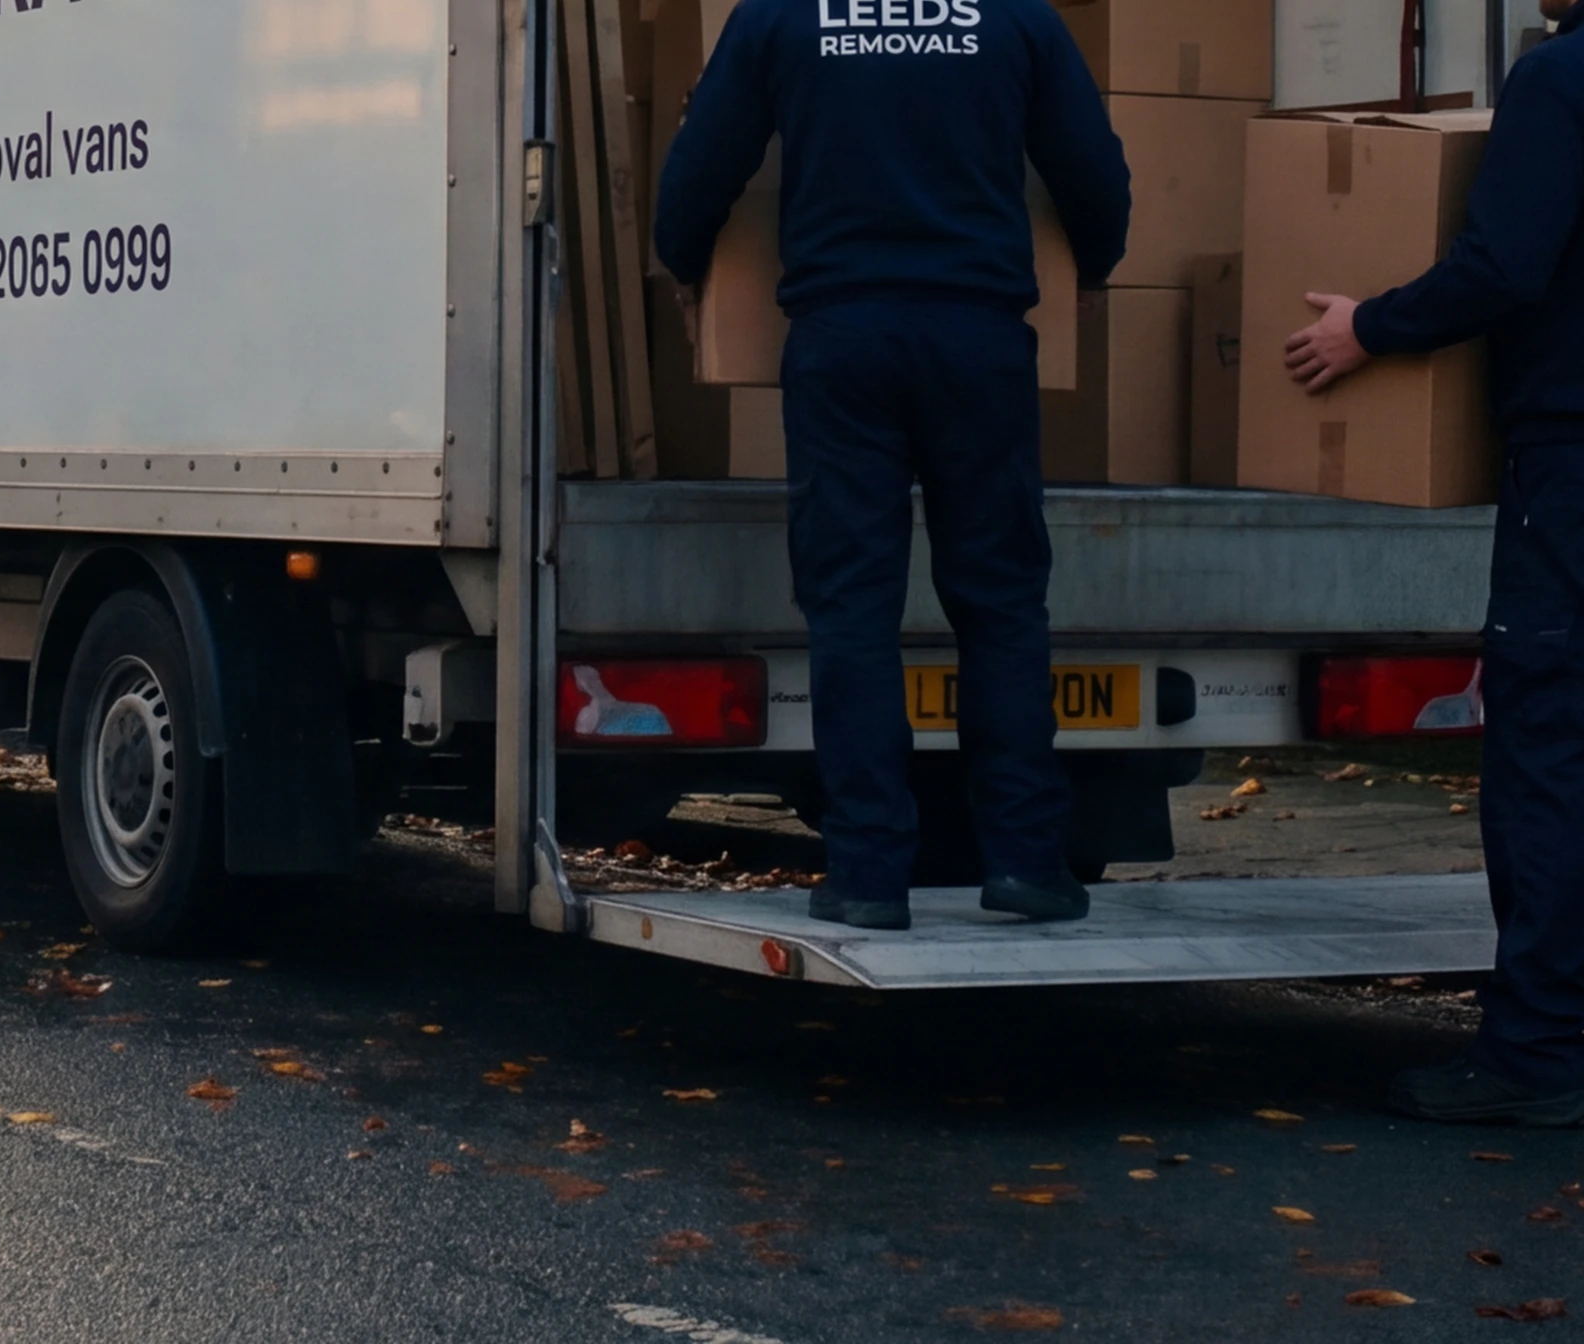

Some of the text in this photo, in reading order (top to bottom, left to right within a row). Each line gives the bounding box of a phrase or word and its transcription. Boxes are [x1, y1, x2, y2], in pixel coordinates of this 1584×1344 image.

[820, 33, 979, 57] REMOVALS
[62, 118, 150, 176] vans
[82, 222, 173, 296] 0999
